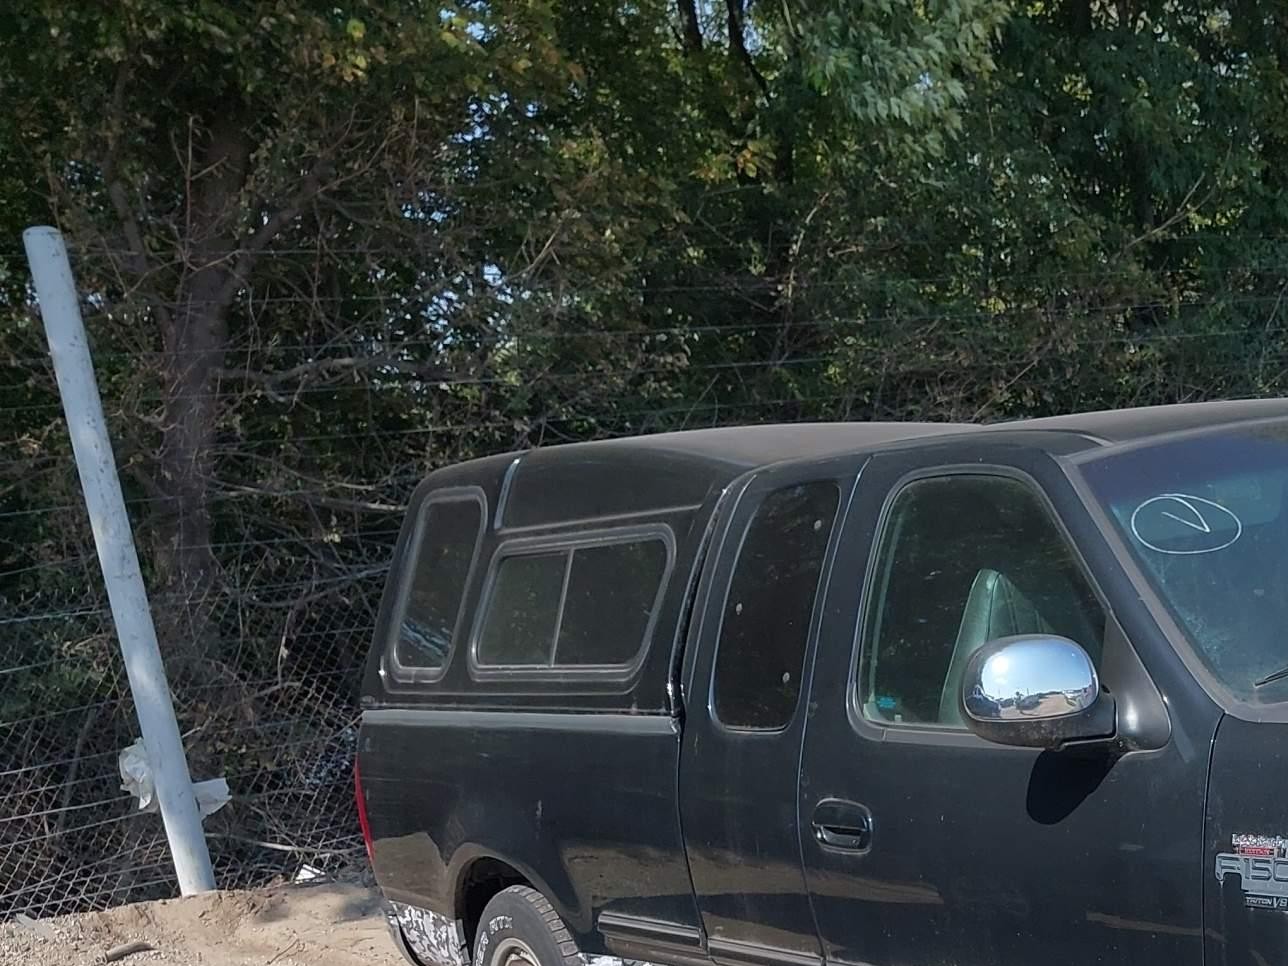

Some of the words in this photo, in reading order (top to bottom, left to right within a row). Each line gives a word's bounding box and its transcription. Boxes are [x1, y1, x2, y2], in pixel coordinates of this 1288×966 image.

[1245, 896, 1273, 906] TRITON
[1273, 897, 1288, 909] V8
[488, 915, 514, 936] RTX
